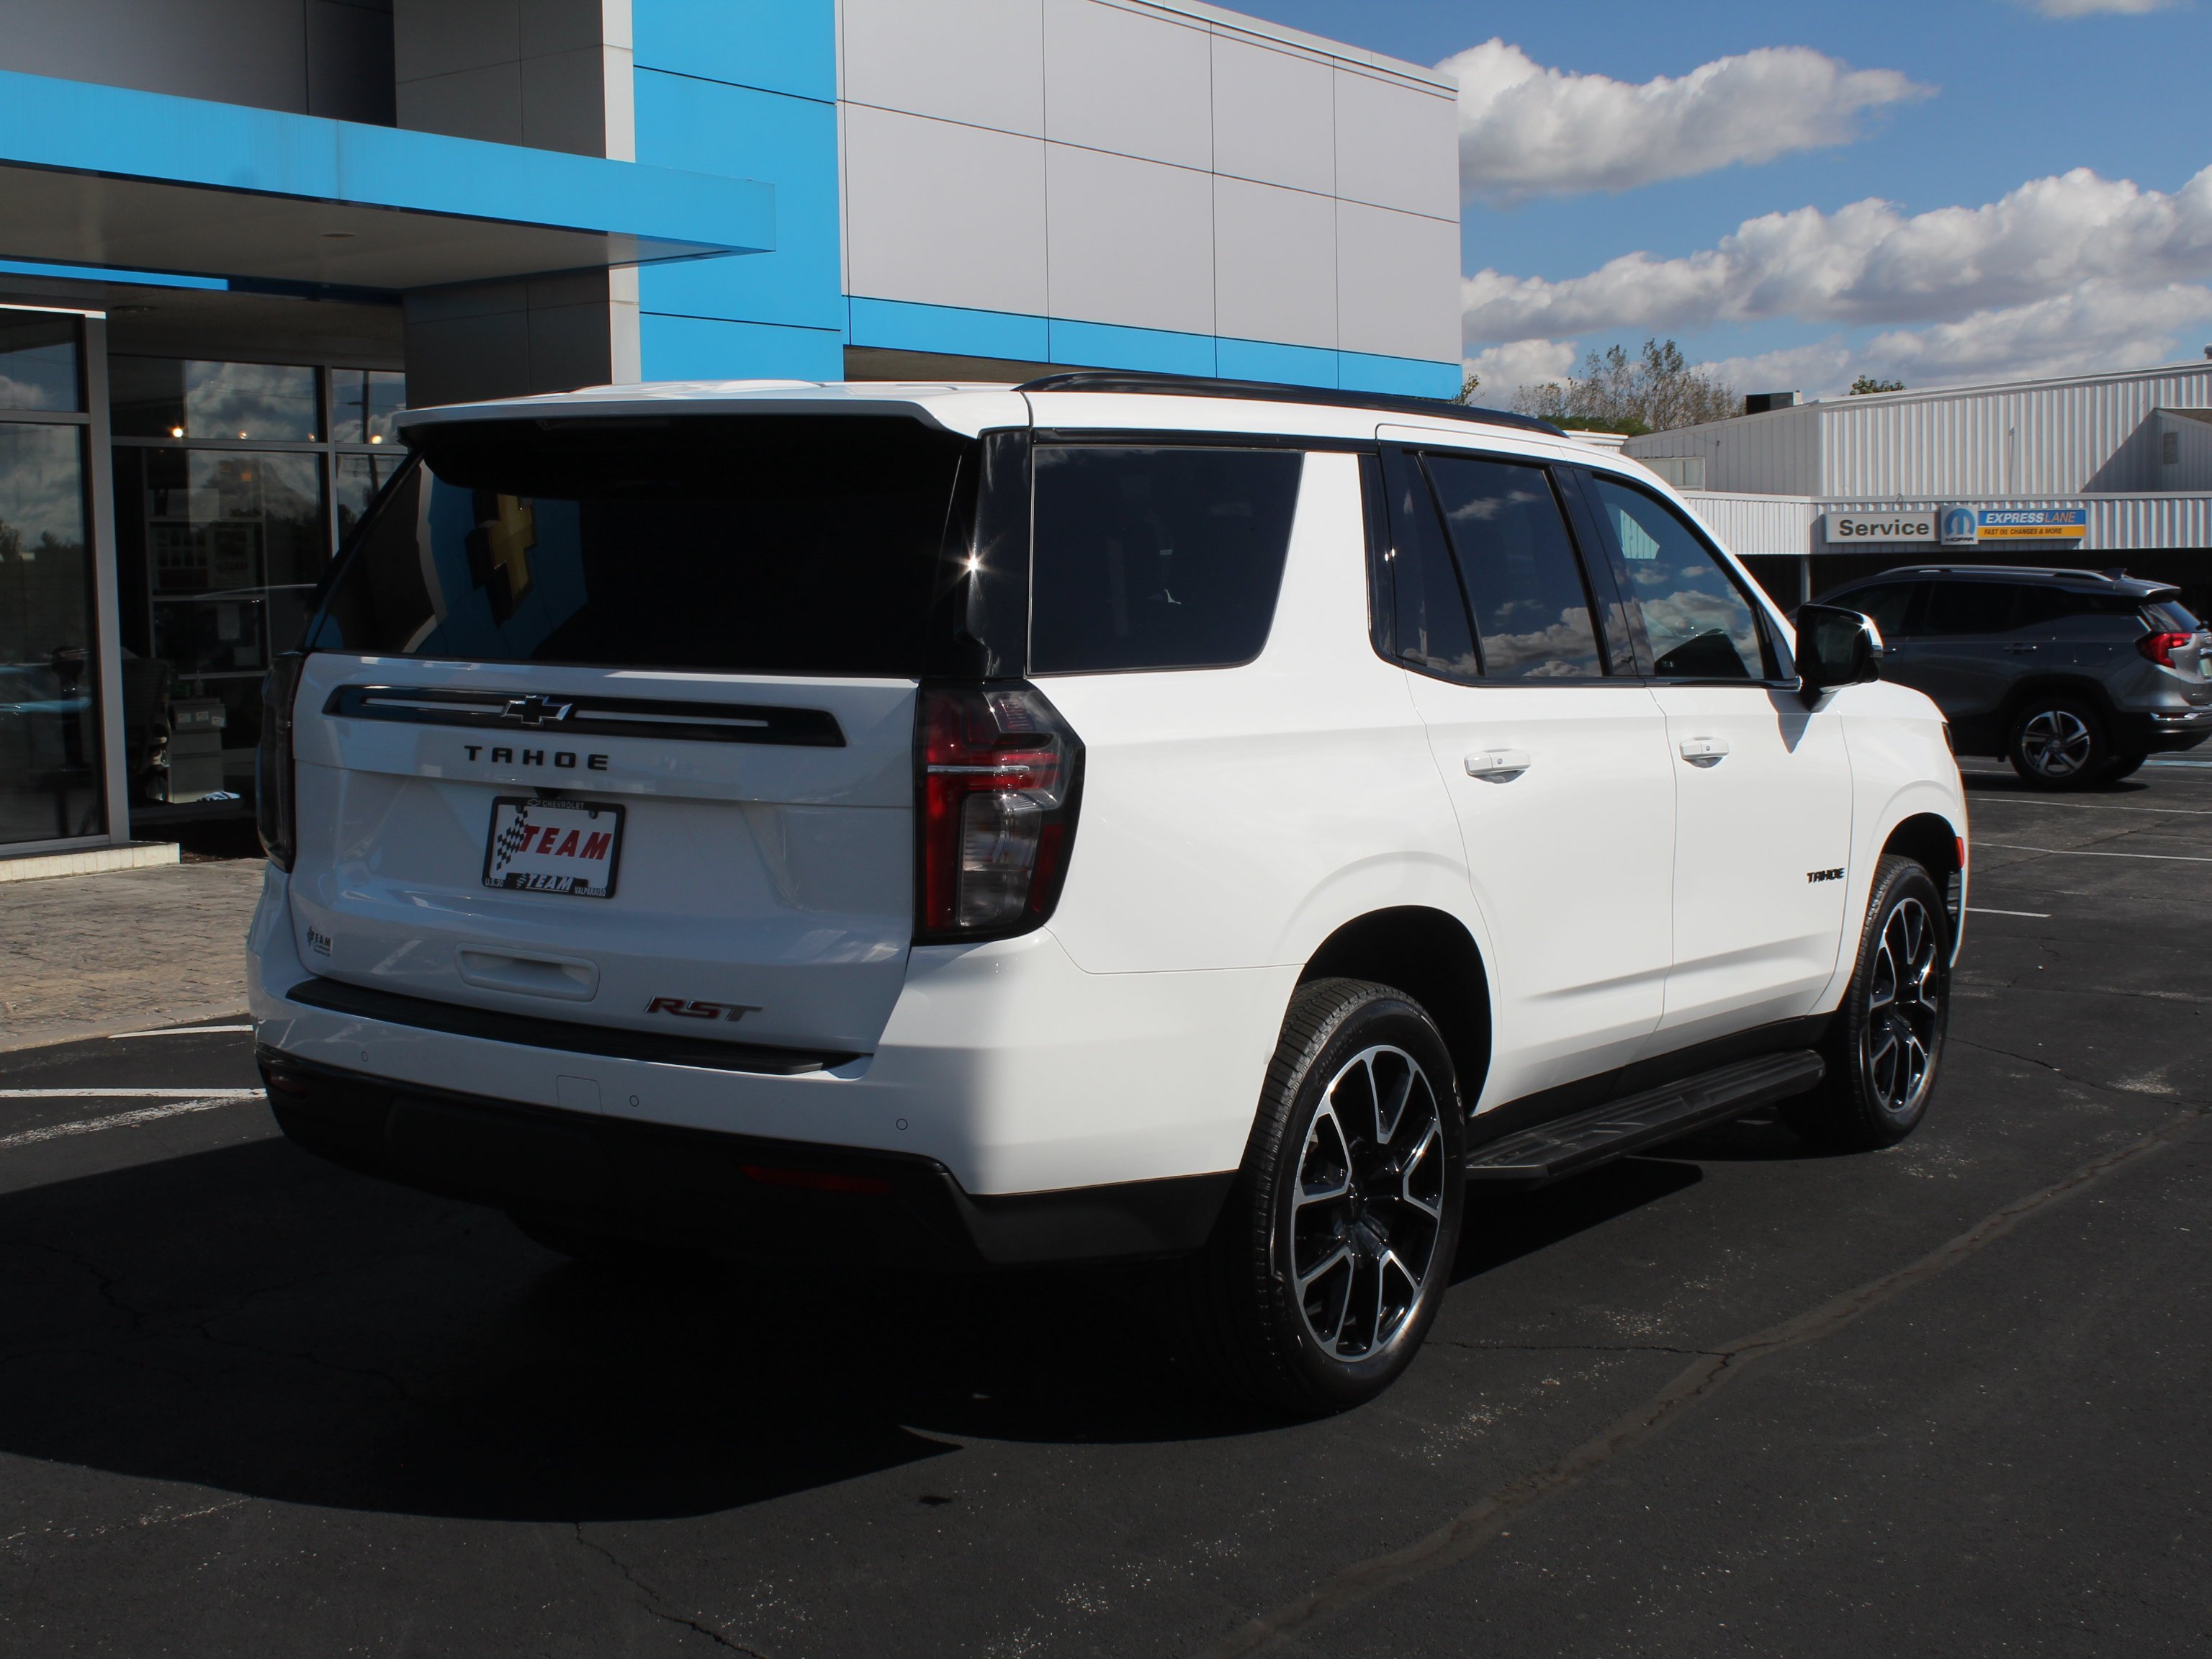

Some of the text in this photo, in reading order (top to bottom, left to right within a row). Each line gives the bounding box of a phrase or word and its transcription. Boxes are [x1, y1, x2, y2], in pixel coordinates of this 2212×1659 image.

[1839, 519, 1930, 536] Service
[464, 745, 609, 771] TAHOE
[542, 800, 585, 810] CHEVROLET
[519, 825, 612, 860] TEAM
[526, 873, 575, 891] TEAM
[574, 886, 606, 897] VALPARAISO
[1807, 867, 1845, 884] TAHOE
[644, 996, 763, 1022] RST
